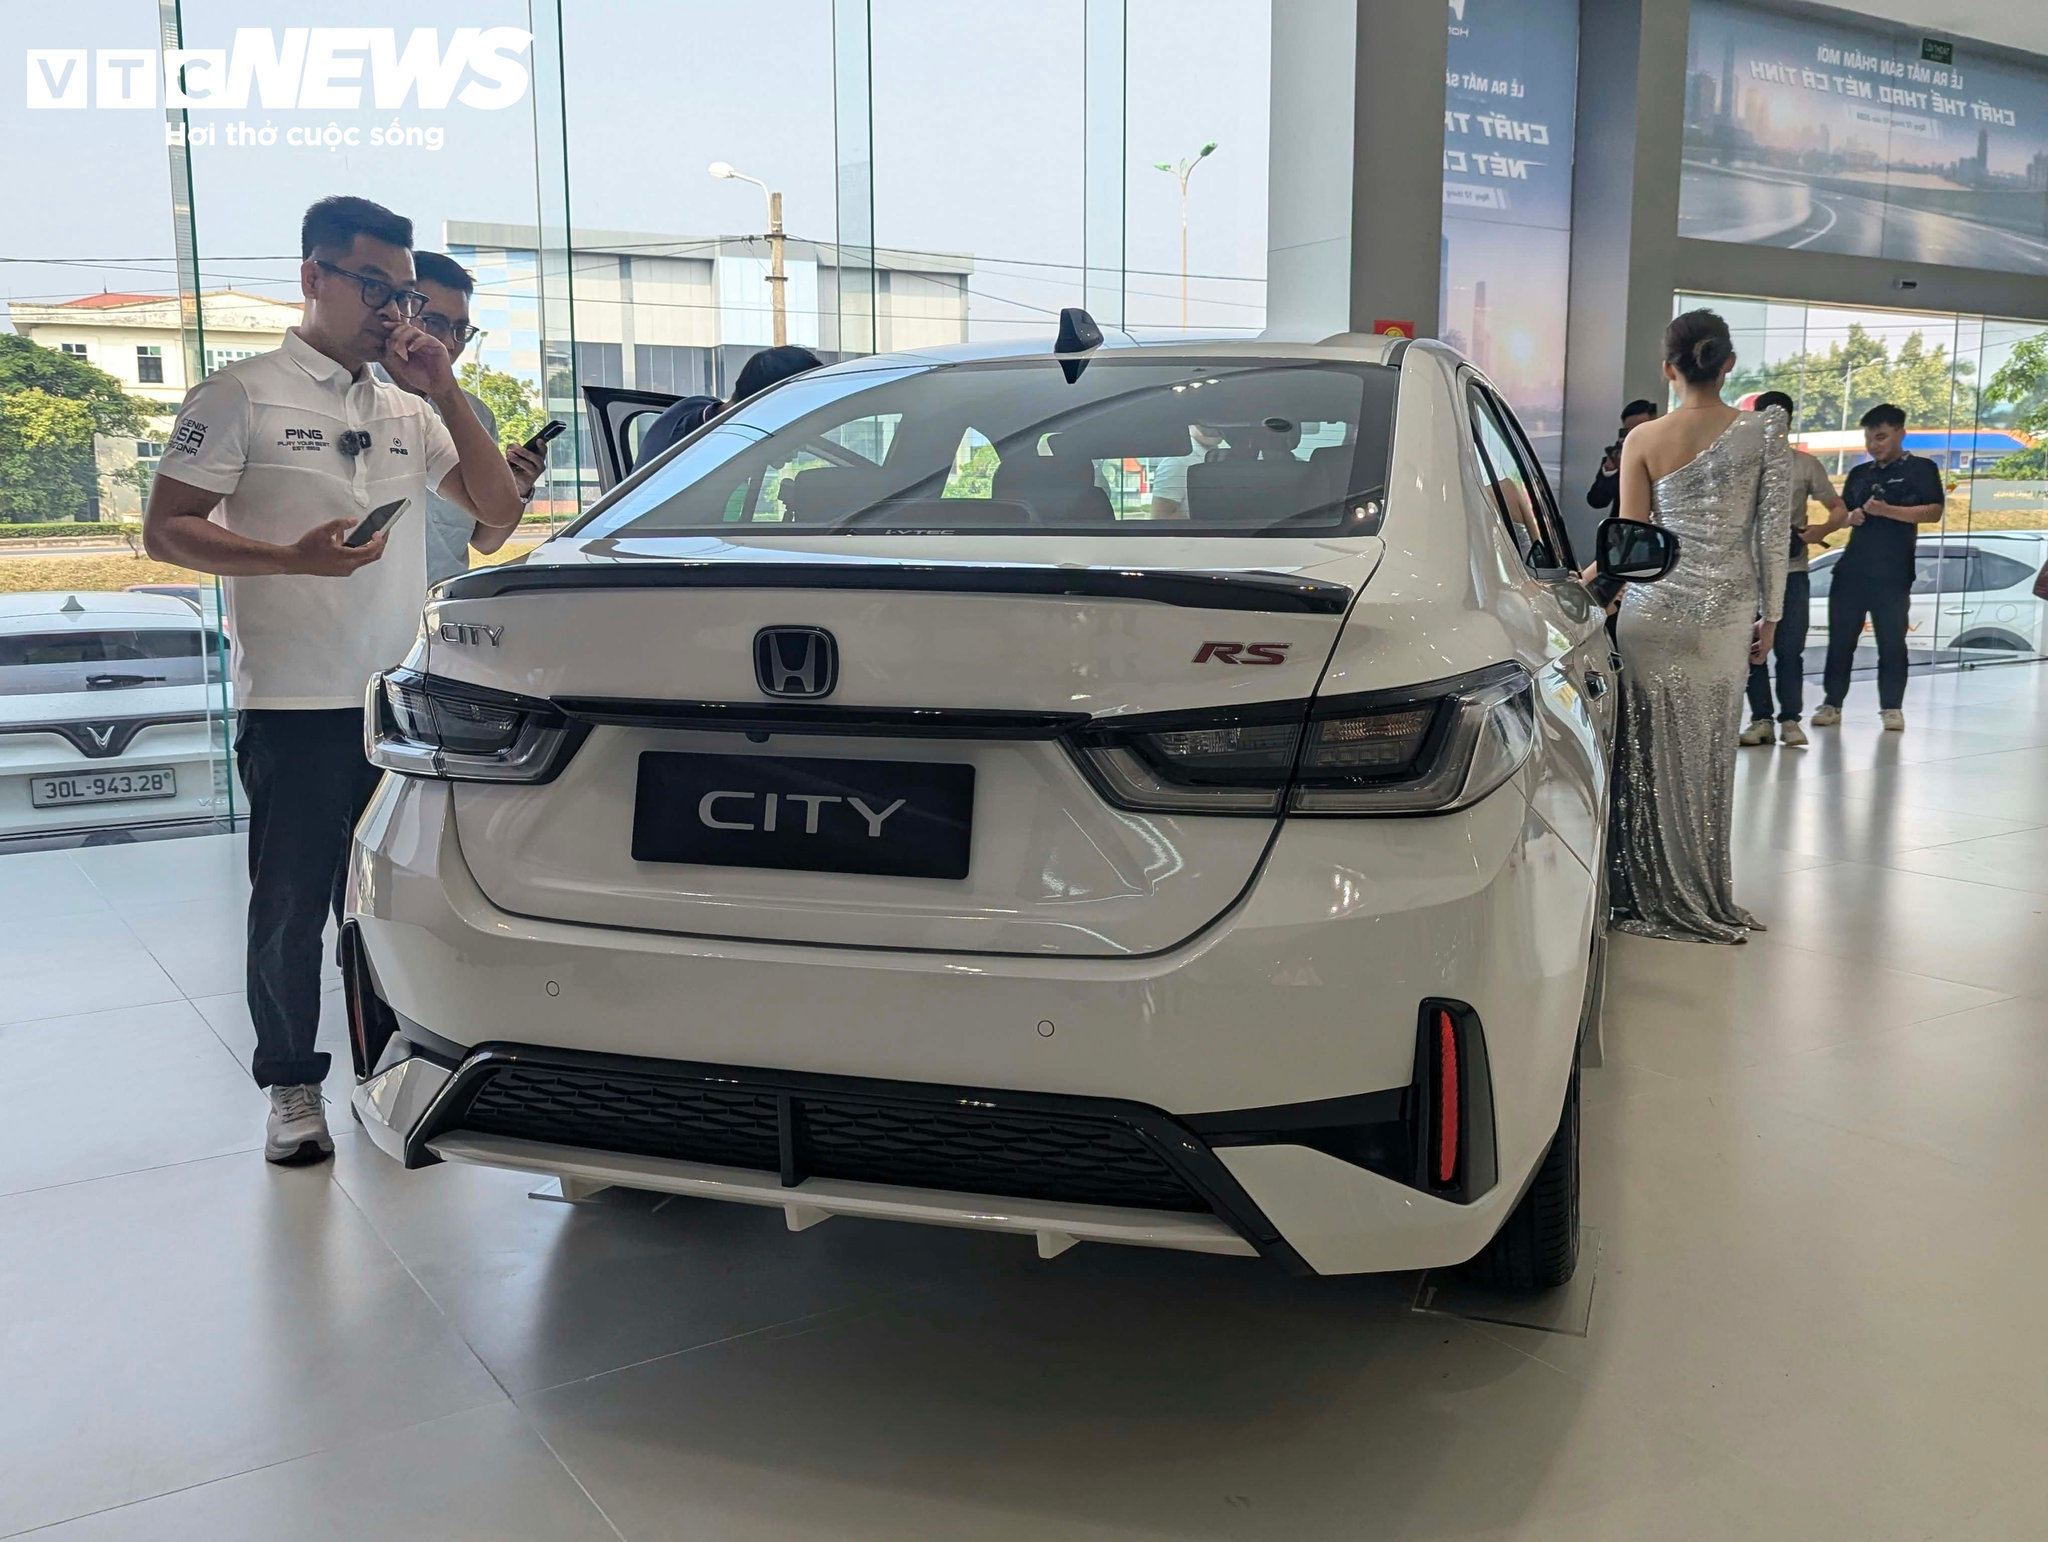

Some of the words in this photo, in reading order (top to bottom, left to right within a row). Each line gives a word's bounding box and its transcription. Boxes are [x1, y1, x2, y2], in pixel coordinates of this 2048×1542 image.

[285, 428, 323, 440] PING
[390, 447, 408, 455] PING
[440, 622, 505, 648] CITY
[1191, 640, 1293, 665] RS
[45, 774, 163, 799] 30L-943.28
[698, 790, 907, 837] CITY
